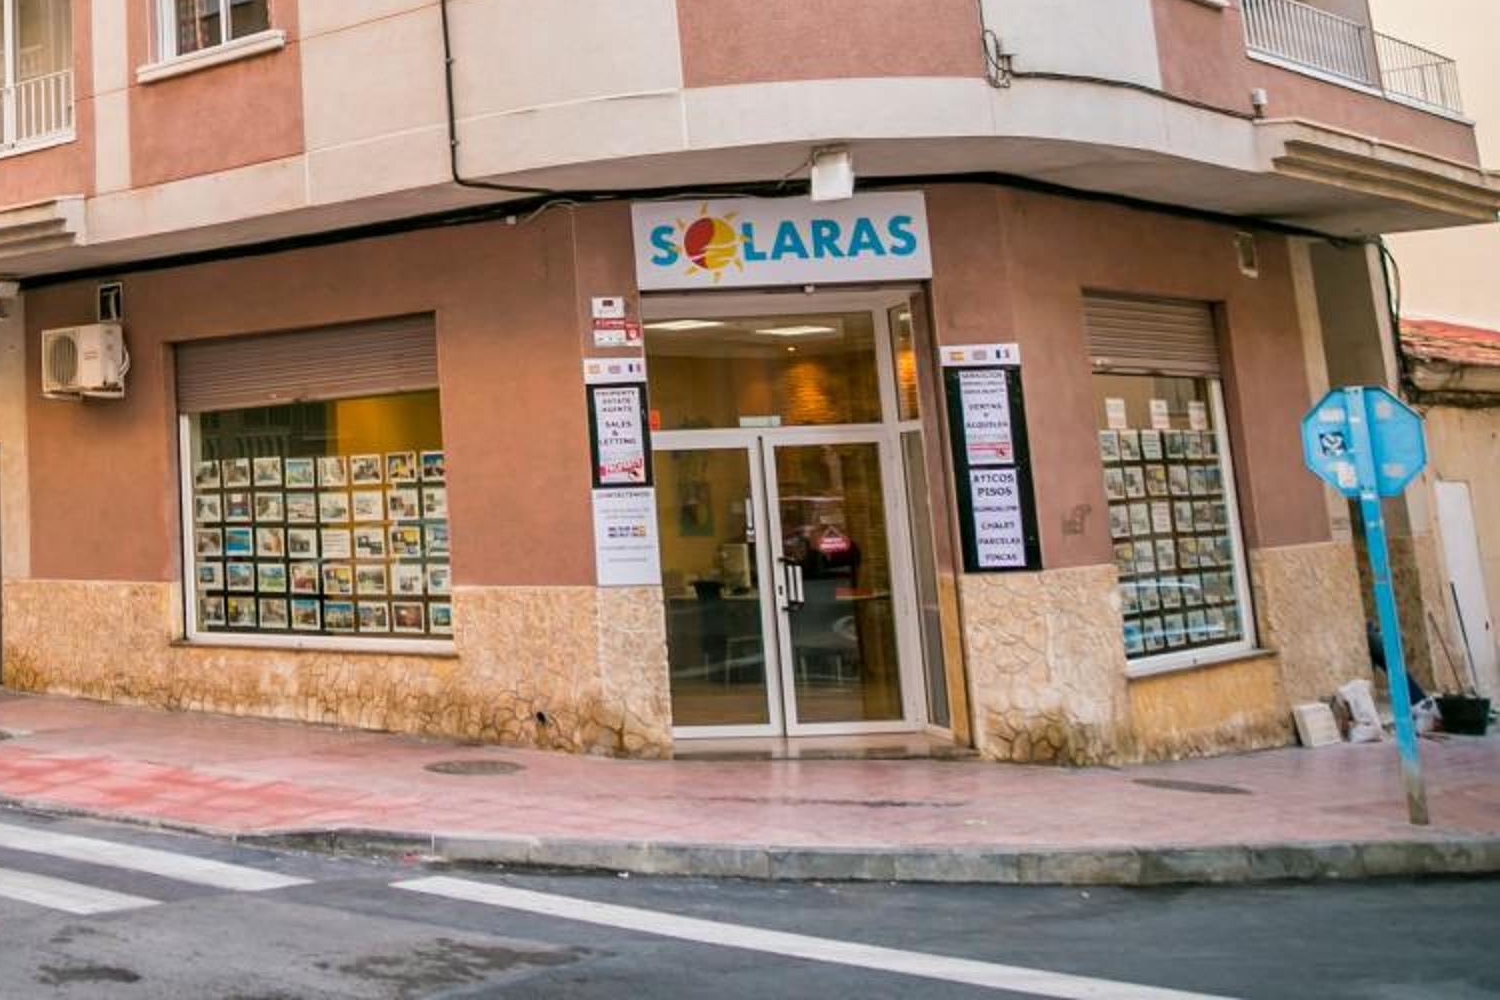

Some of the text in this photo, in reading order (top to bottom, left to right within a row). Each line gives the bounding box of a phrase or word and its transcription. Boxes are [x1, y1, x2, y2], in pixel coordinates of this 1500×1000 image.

[650, 214, 917, 270] SOLARAS
[605, 421, 632, 429] SALES
[977, 487, 1013, 497] PISOS
